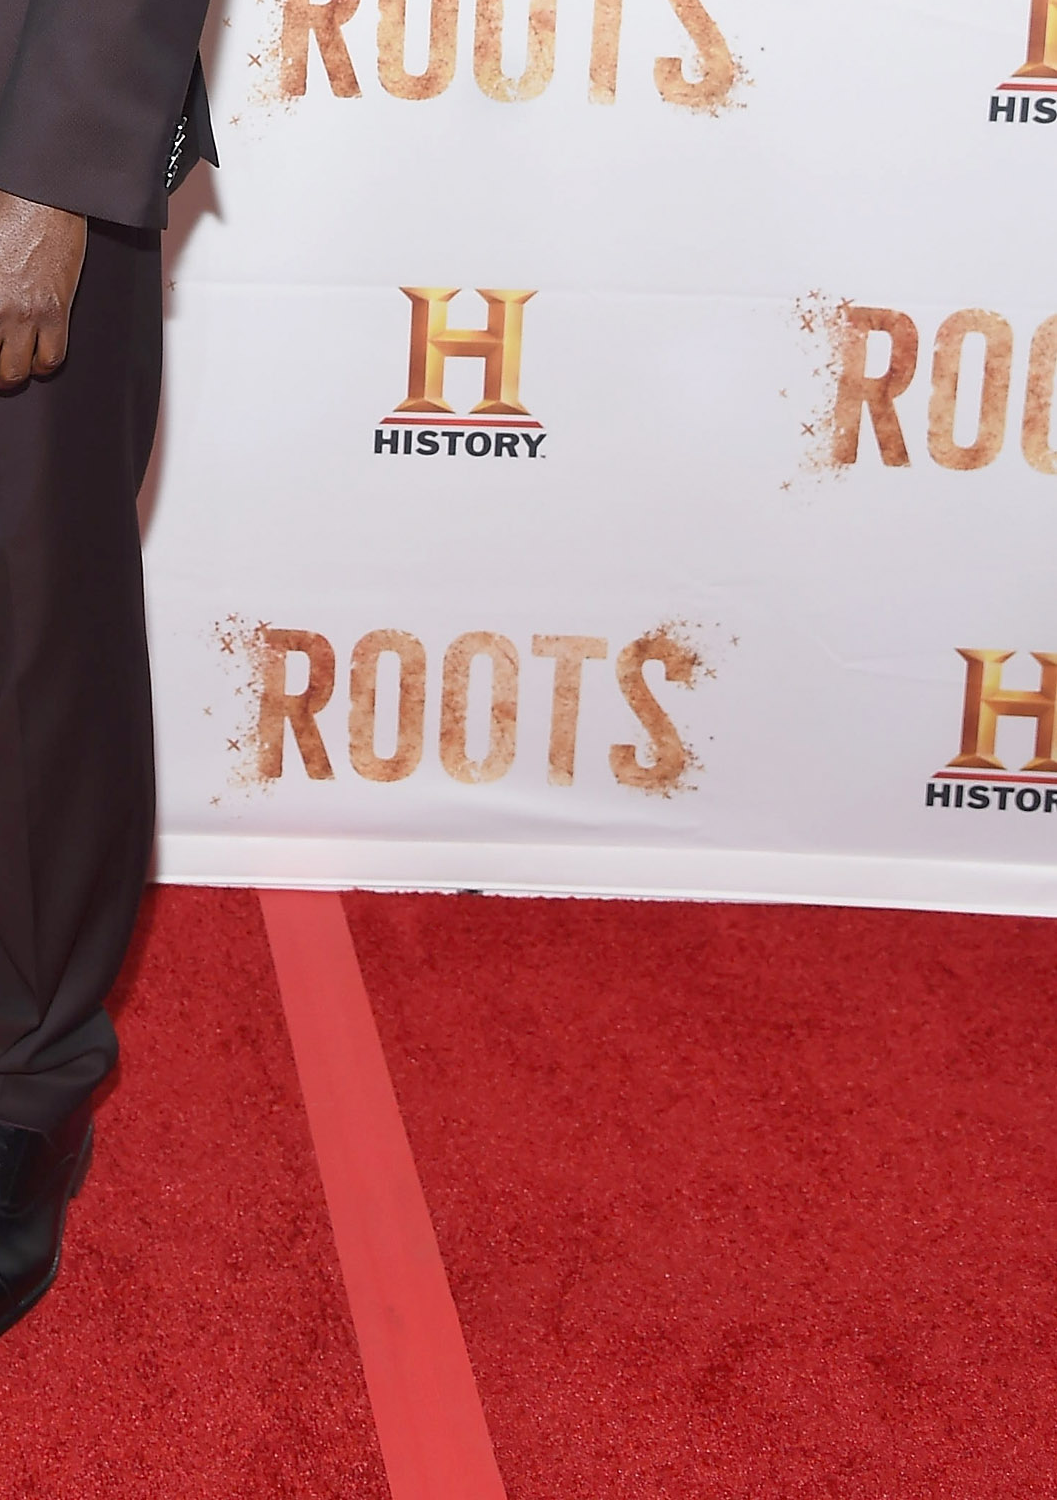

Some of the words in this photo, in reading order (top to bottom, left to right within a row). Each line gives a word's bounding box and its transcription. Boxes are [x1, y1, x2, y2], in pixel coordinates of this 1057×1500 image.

[394, 286, 538, 414] H
[373, 429, 547, 459] HISTORY
[258, 627, 702, 792] ROOTS
